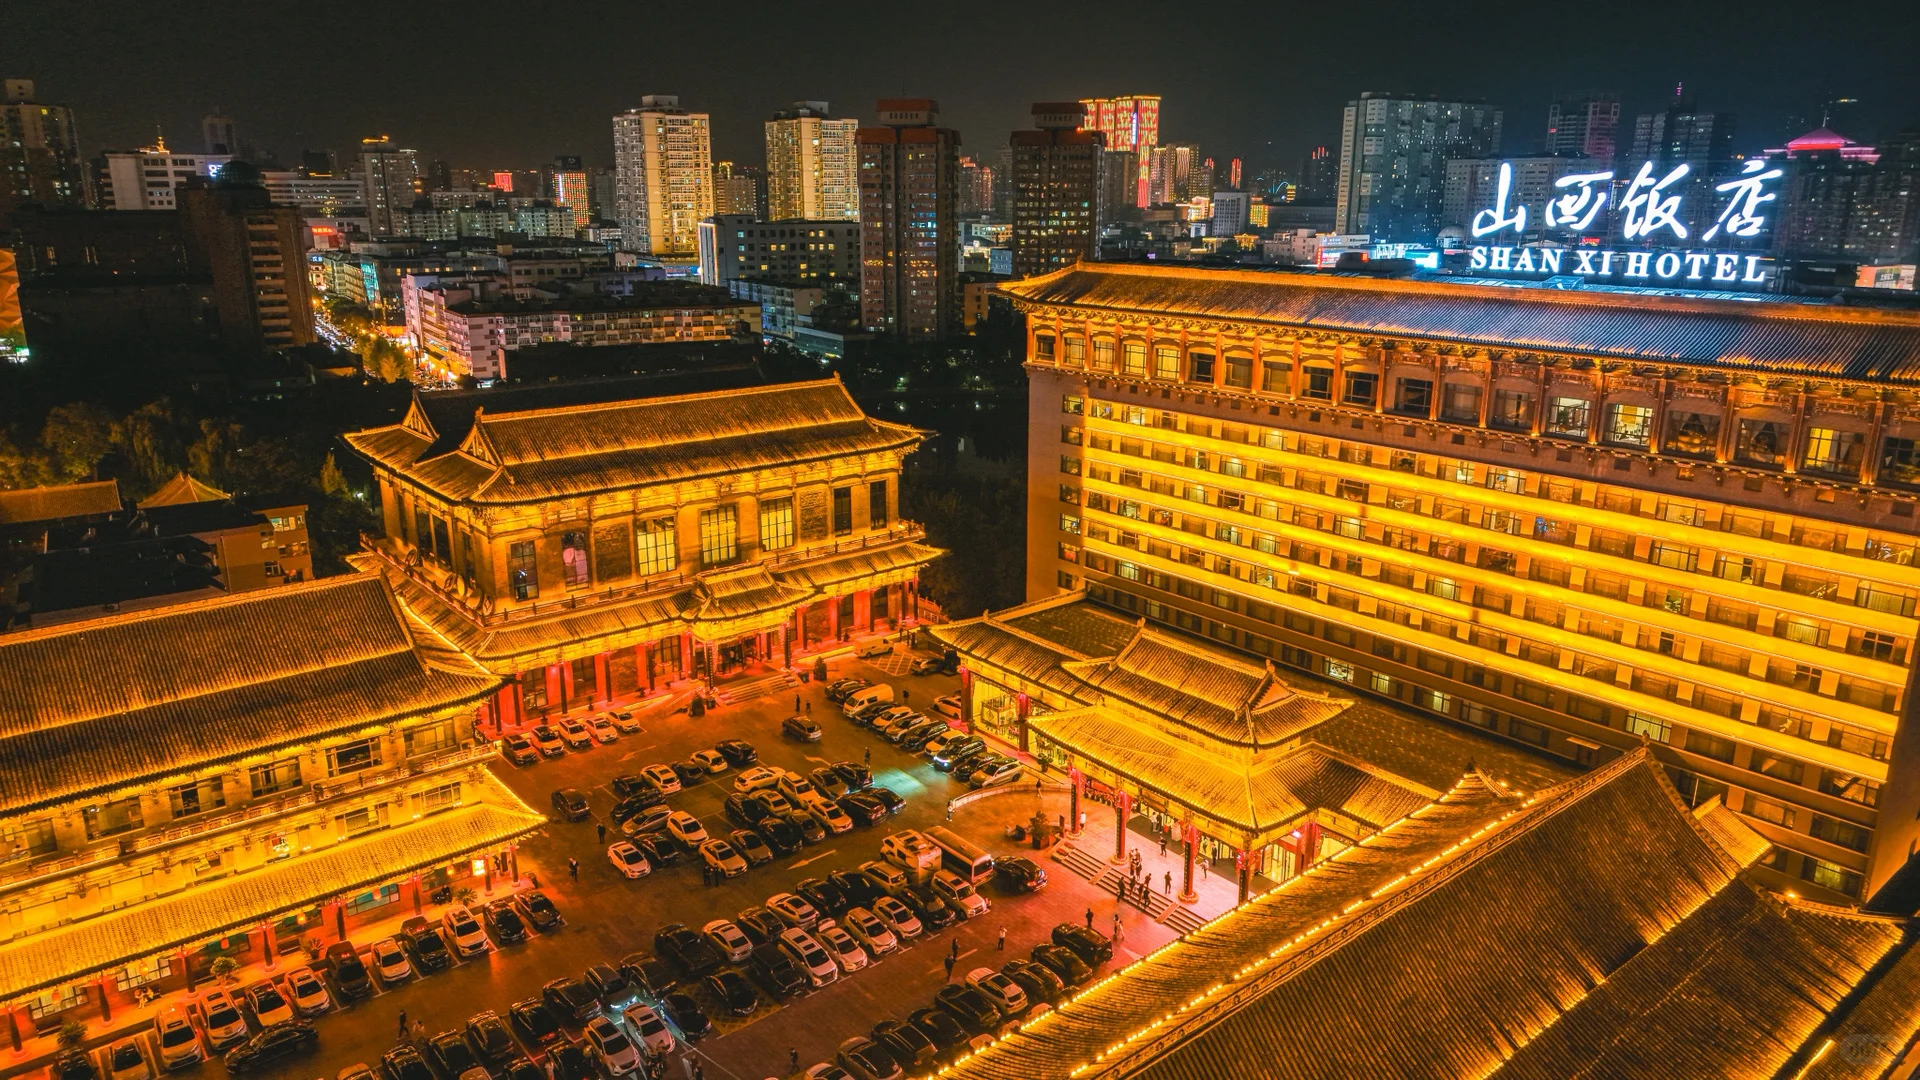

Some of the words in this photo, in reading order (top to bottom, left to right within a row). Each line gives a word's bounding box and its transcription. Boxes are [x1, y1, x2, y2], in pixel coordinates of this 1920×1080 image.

[1471, 160, 1784, 242] 山西饭店
[1470, 245, 1565, 274] SHAN
[1573, 250, 1614, 276] XI
[1624, 252, 1766, 283] HOTEL
